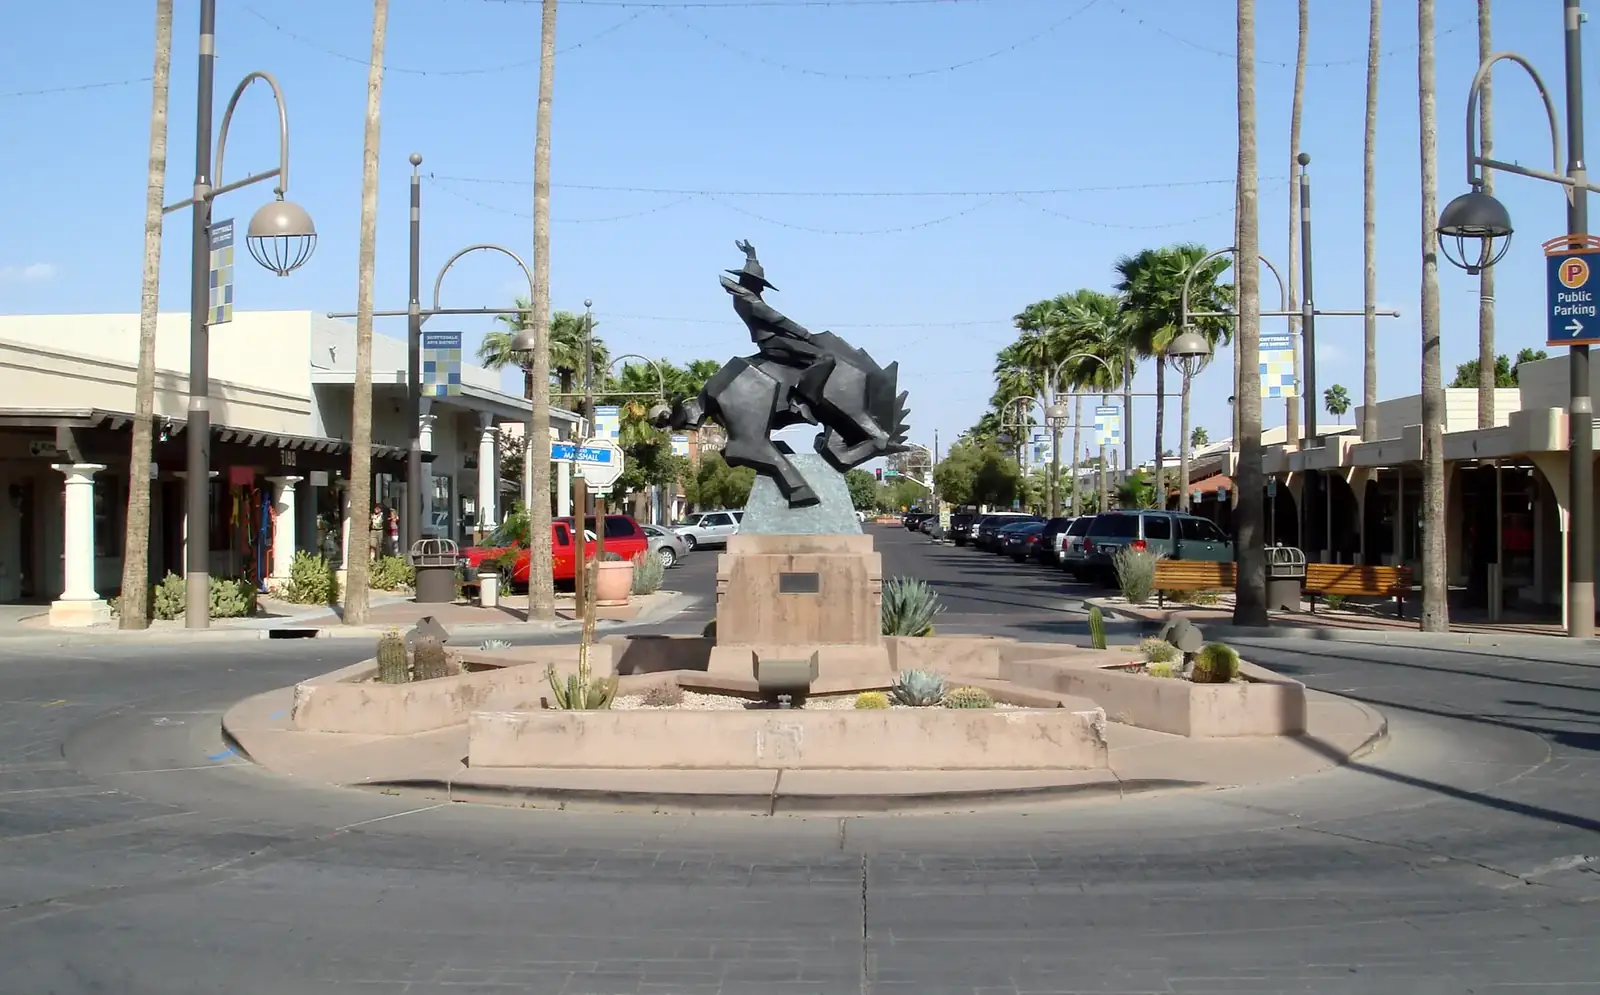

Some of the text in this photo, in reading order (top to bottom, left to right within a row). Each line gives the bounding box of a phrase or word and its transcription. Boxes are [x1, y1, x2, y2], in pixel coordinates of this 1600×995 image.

[1567, 264, 1583, 282] P
[1558, 291, 1592, 303] Public
[1554, 304, 1596, 317] Parking
[563, 451, 599, 461] MASHALL
